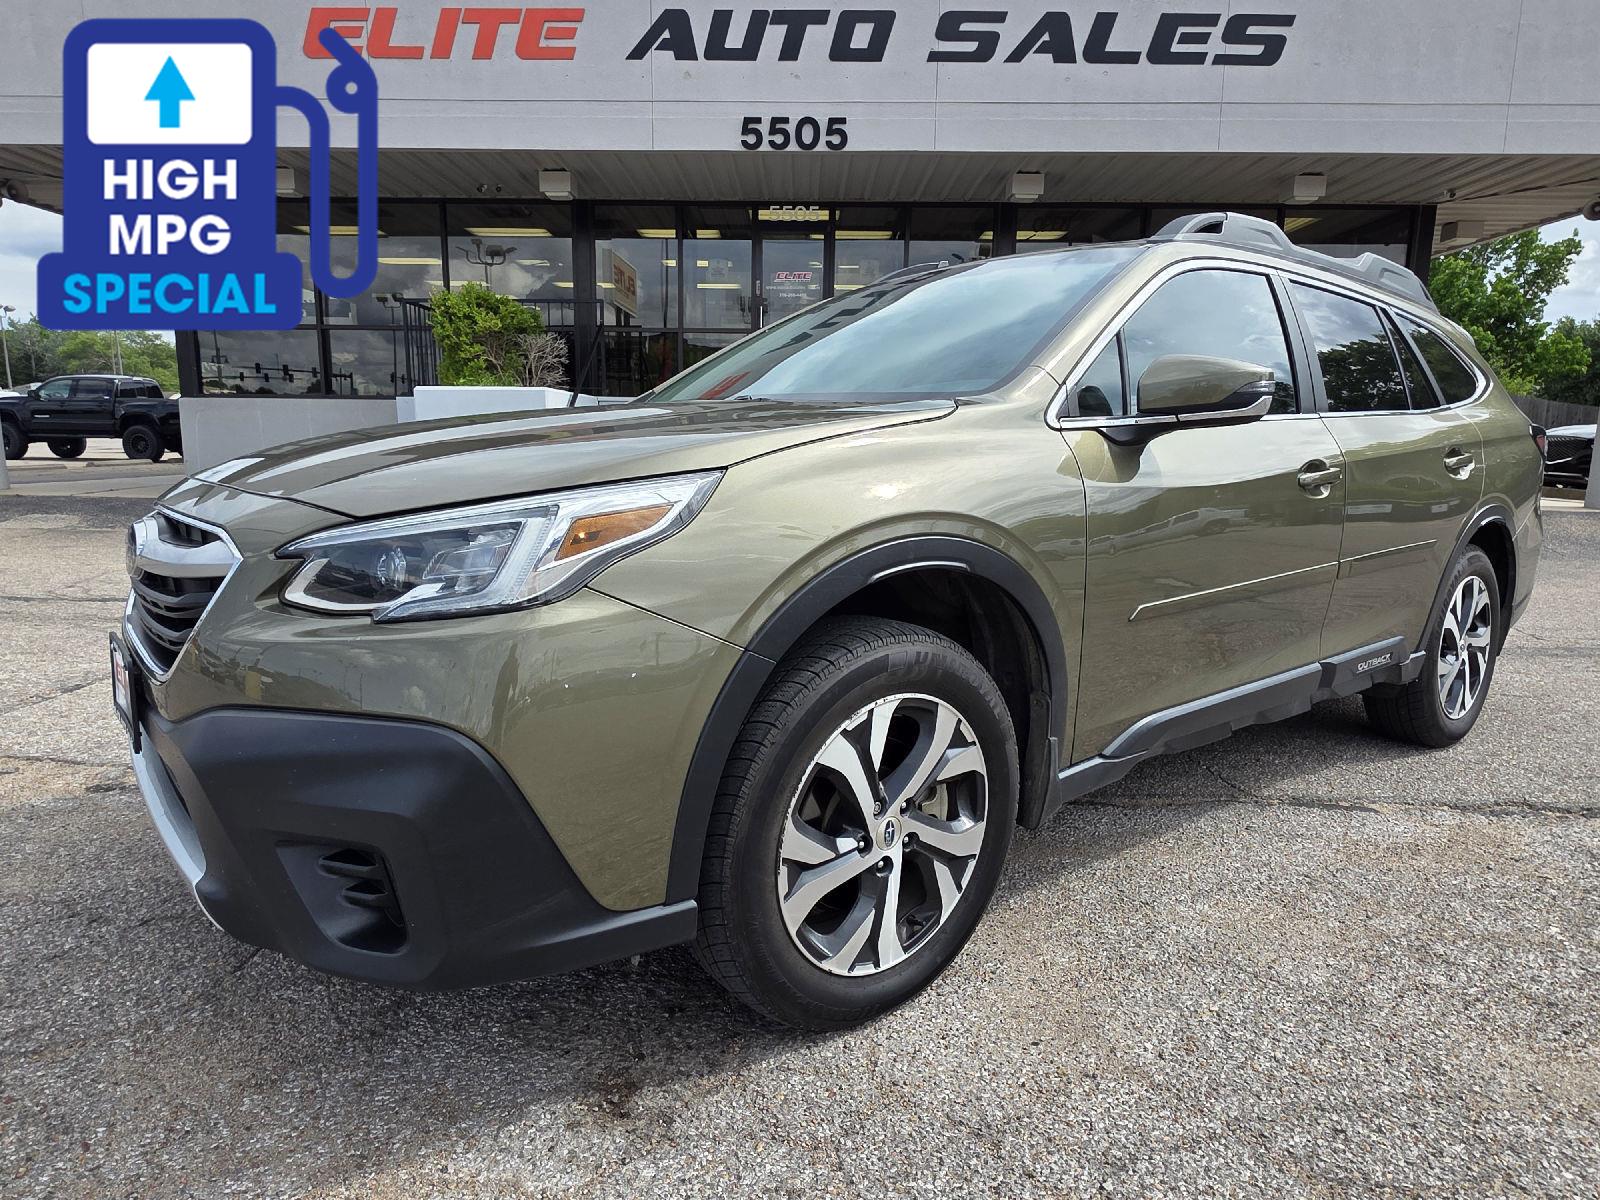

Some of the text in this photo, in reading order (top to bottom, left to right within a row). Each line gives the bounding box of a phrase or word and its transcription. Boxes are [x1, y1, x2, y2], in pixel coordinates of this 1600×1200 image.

[304, 8, 1296, 66] ELITE AUTO SALES
[741, 117, 848, 150] 5505
[769, 206, 819, 221] 5505
[776, 272, 812, 280] ELITE
[1357, 653, 1391, 671] OUTBACK
